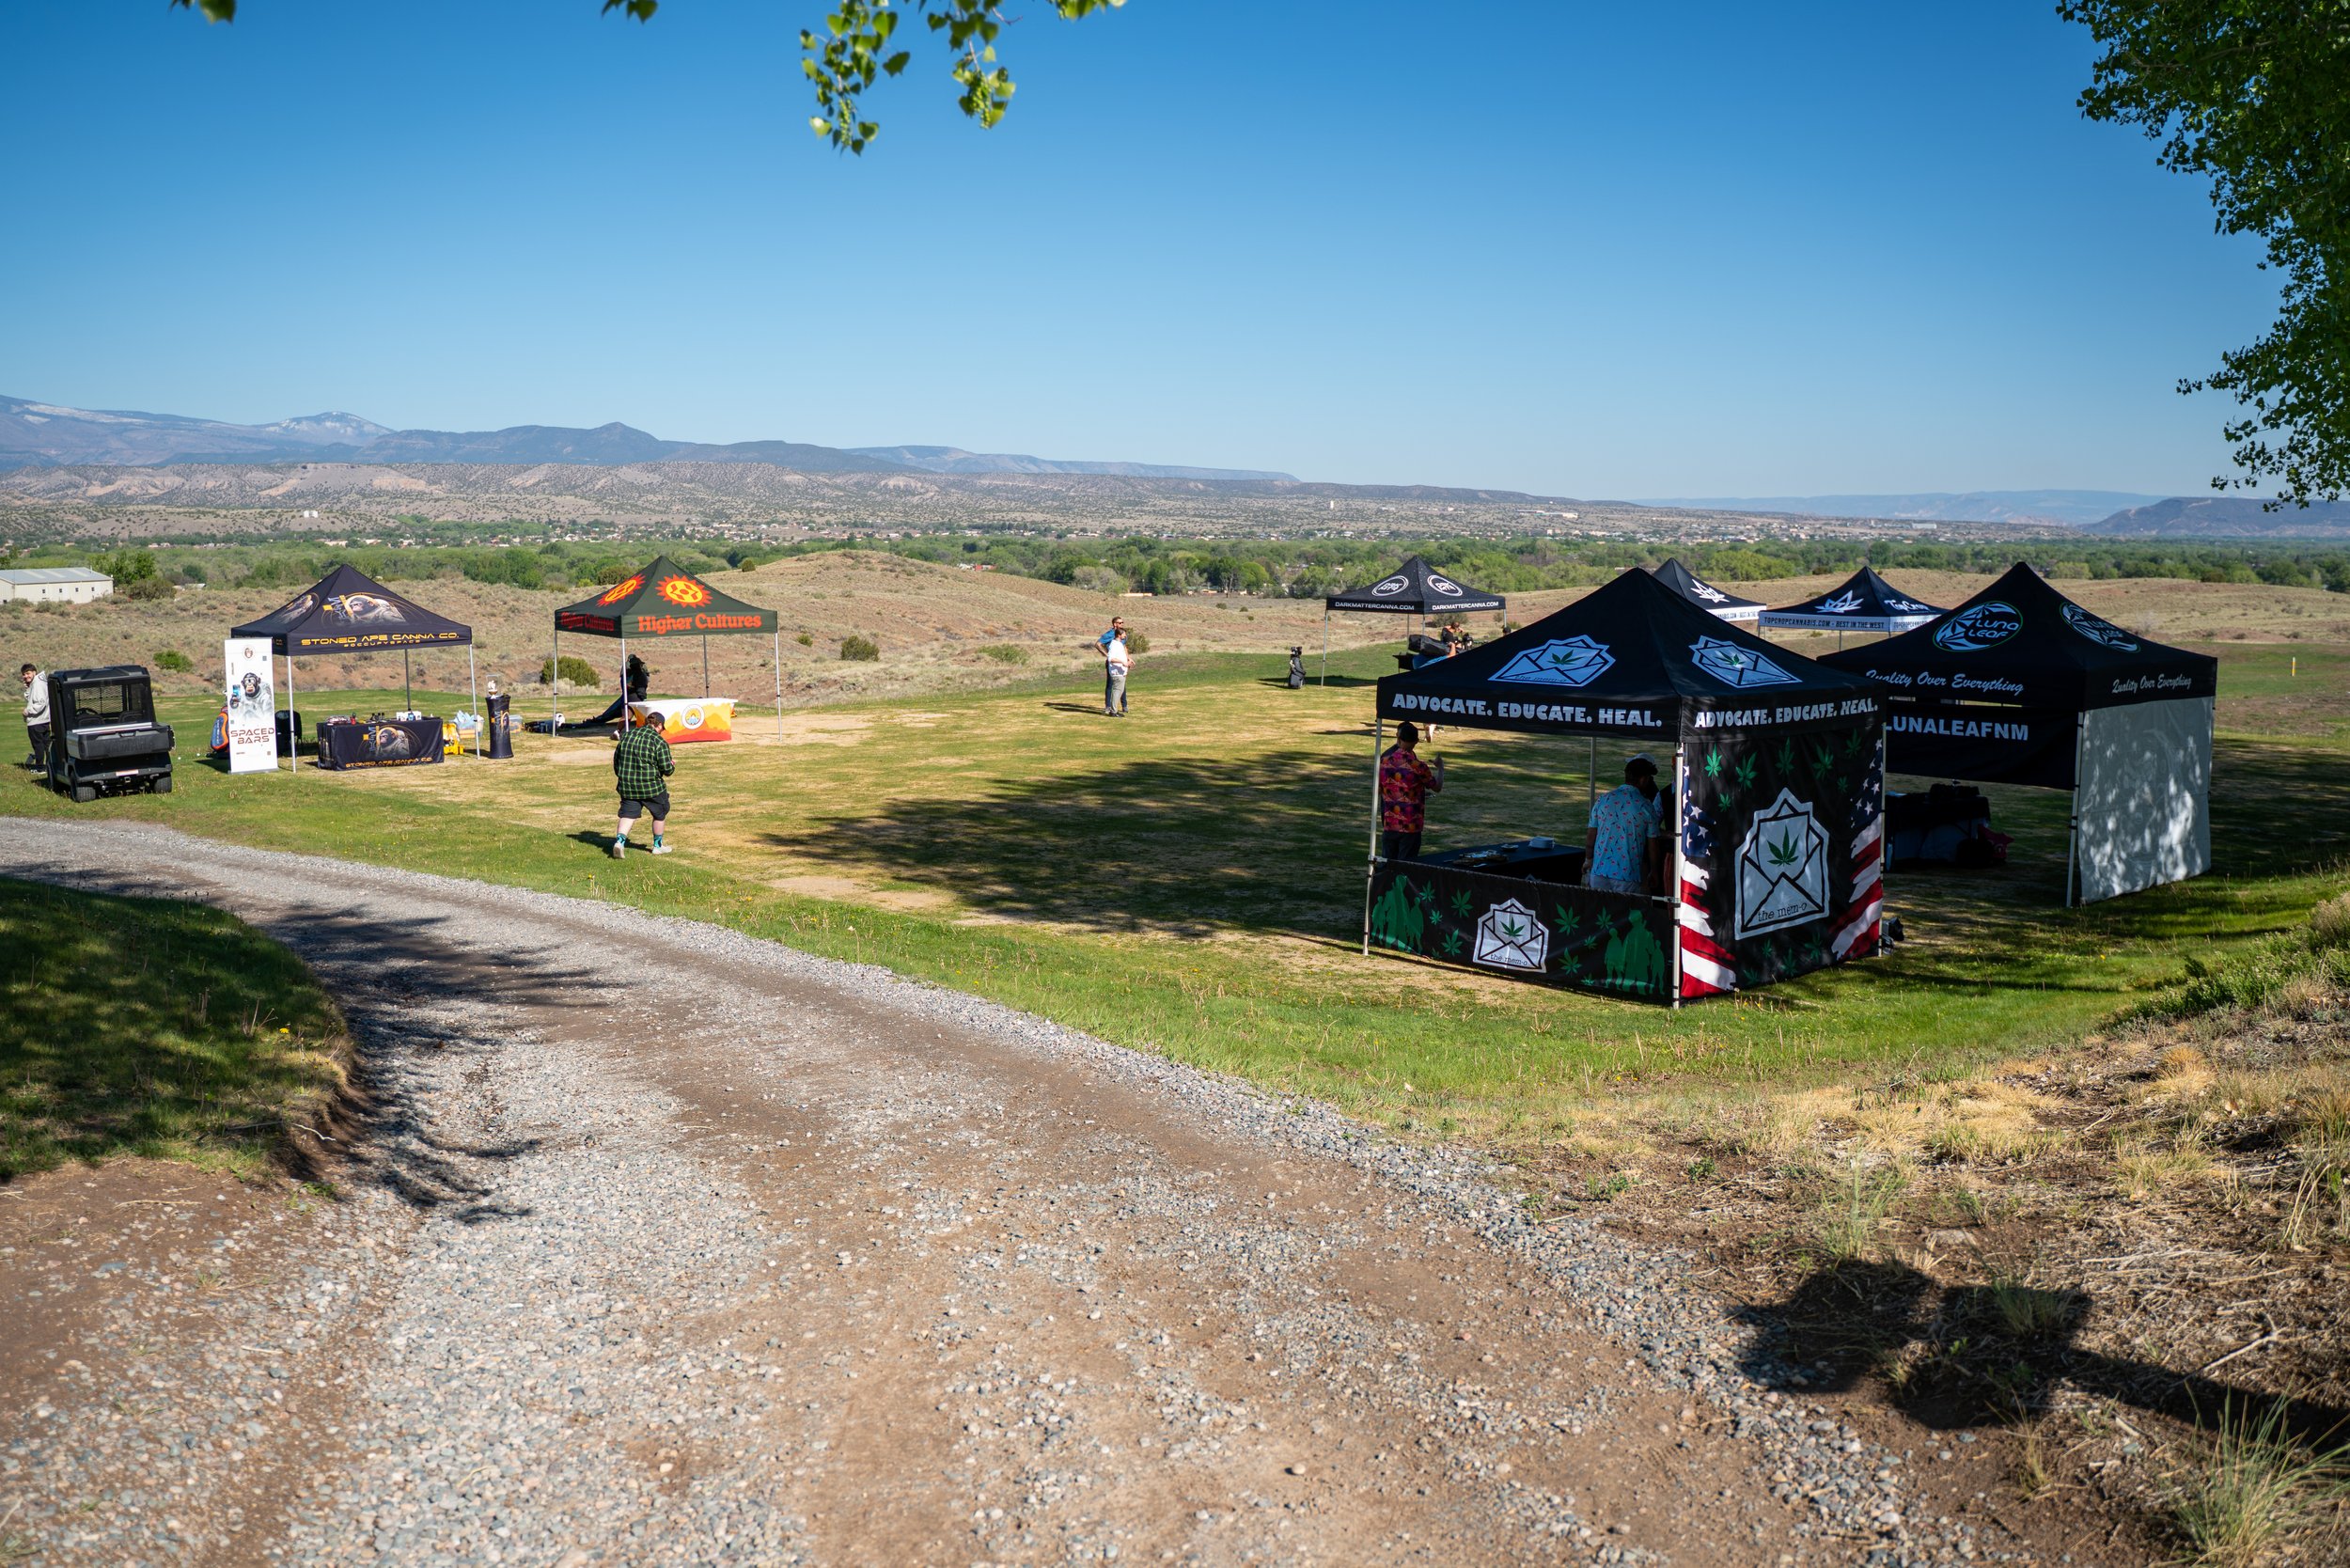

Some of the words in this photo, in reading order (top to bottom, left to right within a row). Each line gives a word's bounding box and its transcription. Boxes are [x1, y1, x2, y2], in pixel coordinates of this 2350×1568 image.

[1335, 601, 1415, 610] DARKMATTERCANNA.COM
[1432, 601, 1498, 611] DARKMATTERCANNA.COM
[585, 613, 614, 631] Cultures
[637, 616, 693, 635] Higher
[695, 613, 761, 630] Cultures
[1764, 617, 1831, 628] TOPCROPCANNABIS.COM
[301, 636, 357, 646] STONED
[361, 634, 388, 642] APE
[1918, 671, 1947, 686] Over
[1951, 673, 2025, 697] Everything
[2111, 679, 2138, 694] Quality
[2139, 675, 2155, 689] Over
[2157, 673, 2192, 690] Everything
[1392, 693, 1493, 716] ADVOCATE.
[1498, 702, 1592, 724] EDUCATE.
[1598, 708, 1662, 728] HEAL.
[1694, 709, 1772, 729] ADVOCATE.
[1776, 702, 1837, 724] EDUCATE.
[1840, 698, 1878, 715] HEAL.
[230, 728, 275, 737] SPACED
[1886, 715, 2029, 741] UNALEAFNM
[237, 735, 270, 745] BARS
[1758, 910, 1774, 922] the
[1777, 902, 1808, 917] mem-o
[1504, 957, 1528, 965] mem-o
